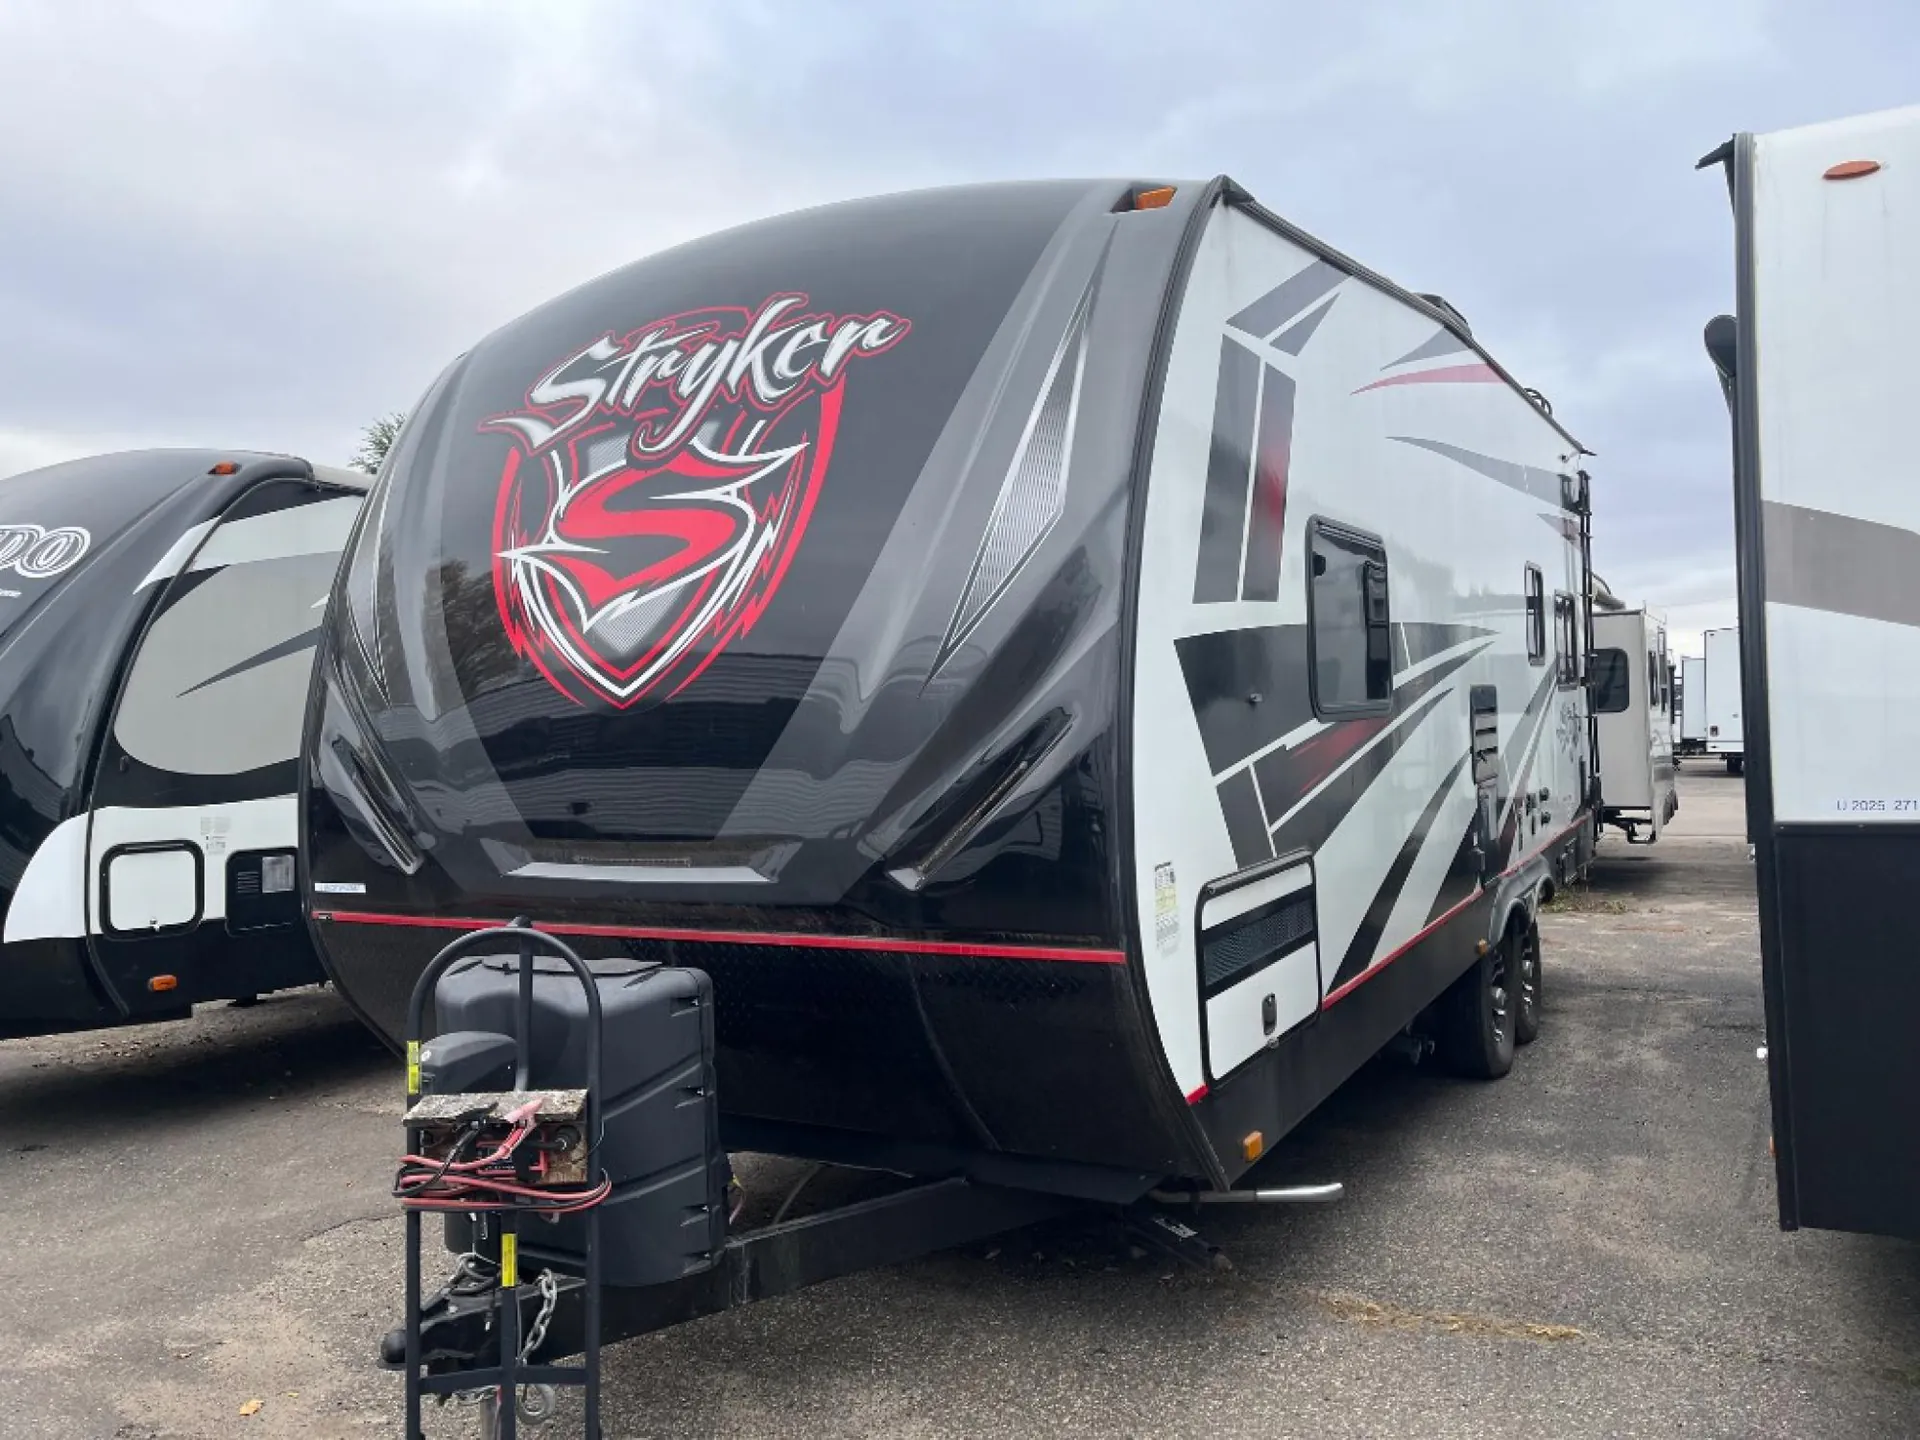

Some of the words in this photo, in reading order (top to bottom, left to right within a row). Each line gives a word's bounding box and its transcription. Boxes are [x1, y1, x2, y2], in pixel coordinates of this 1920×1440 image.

[482, 294, 908, 455] Stryker
[1851, 799, 1885, 811] 2025
[1894, 799, 1918, 811] 271
